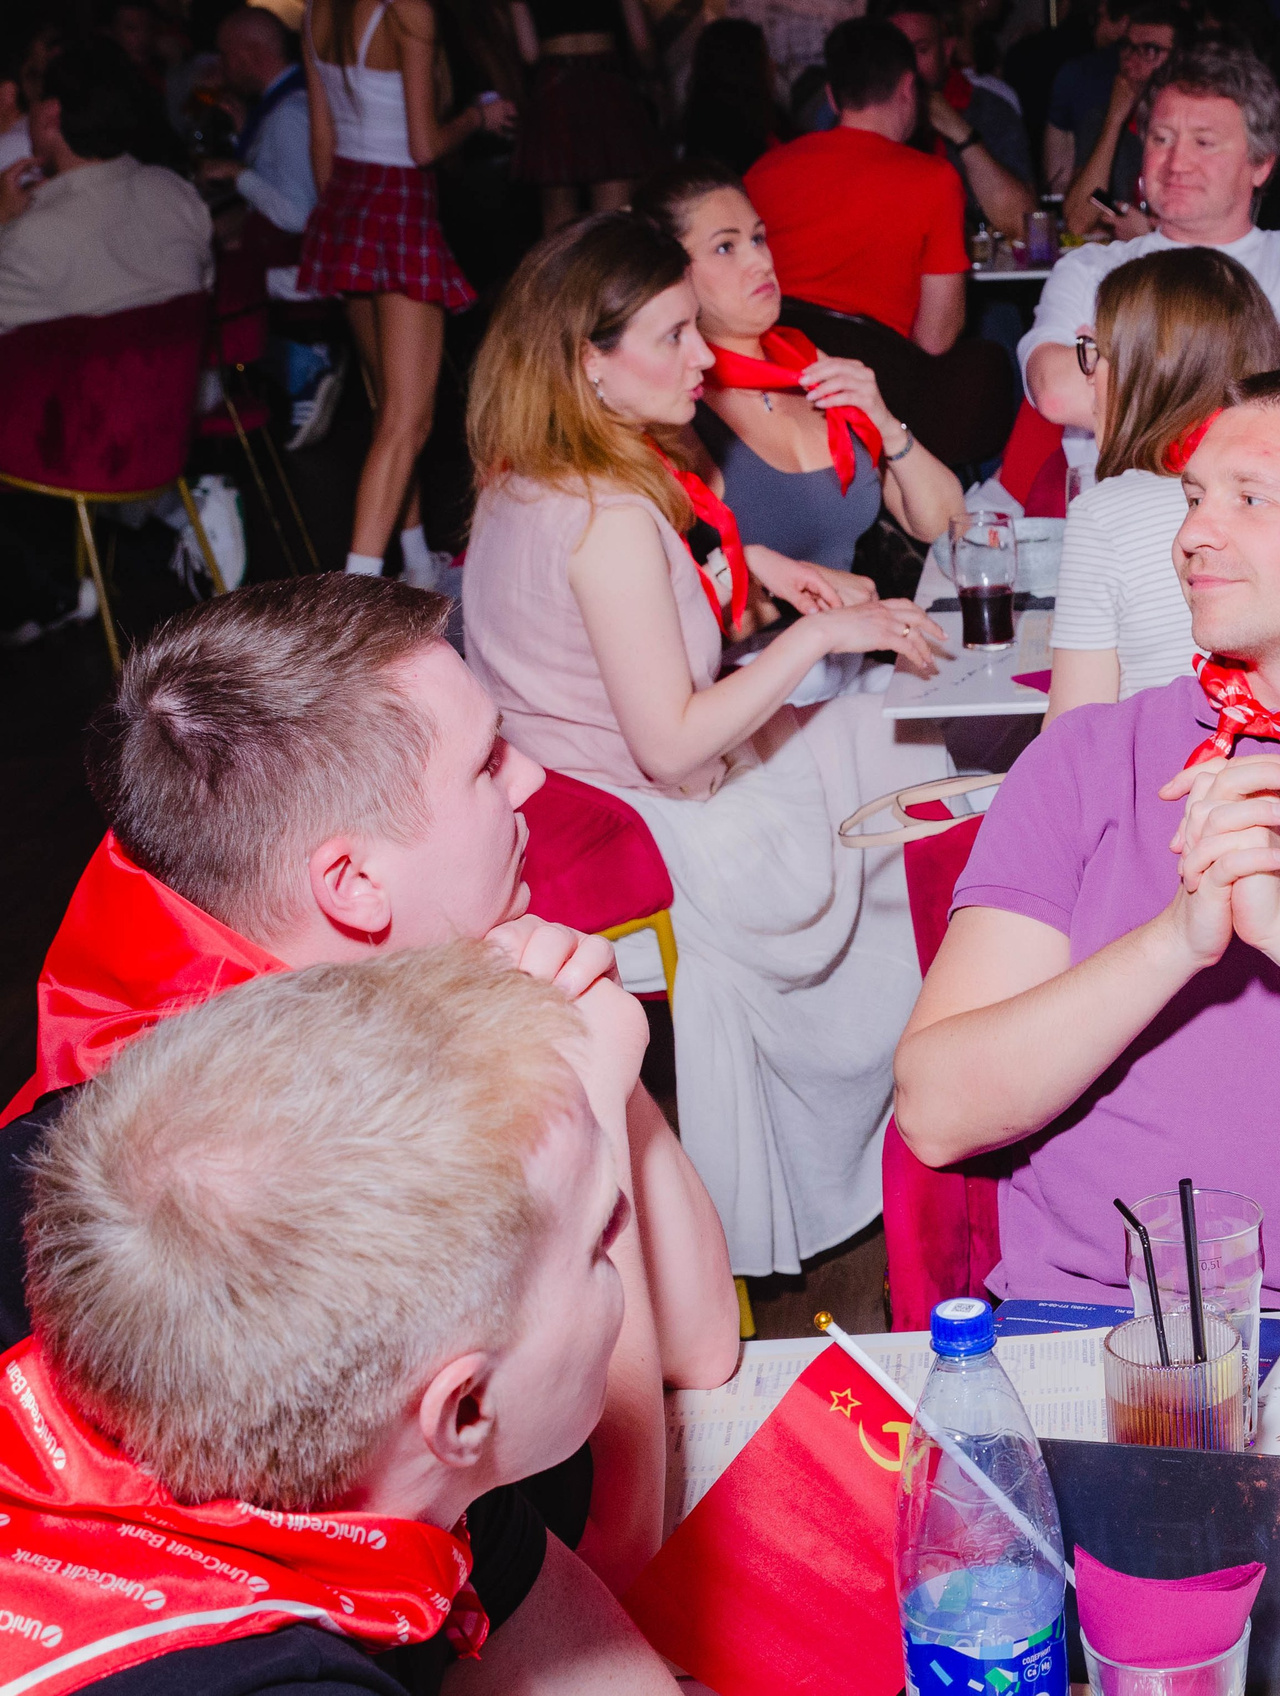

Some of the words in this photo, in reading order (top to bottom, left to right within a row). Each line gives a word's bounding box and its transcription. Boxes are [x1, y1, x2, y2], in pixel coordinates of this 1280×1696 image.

[6, 1360, 27, 1395] Ban
[116, 1523, 167, 1549] Bank
[286, 1513, 367, 1546] UniCredit
[11, 1548, 63, 1574] Bank
[165, 1539, 250, 1584] UniCredit
[61, 1562, 146, 1601] UniCredit
